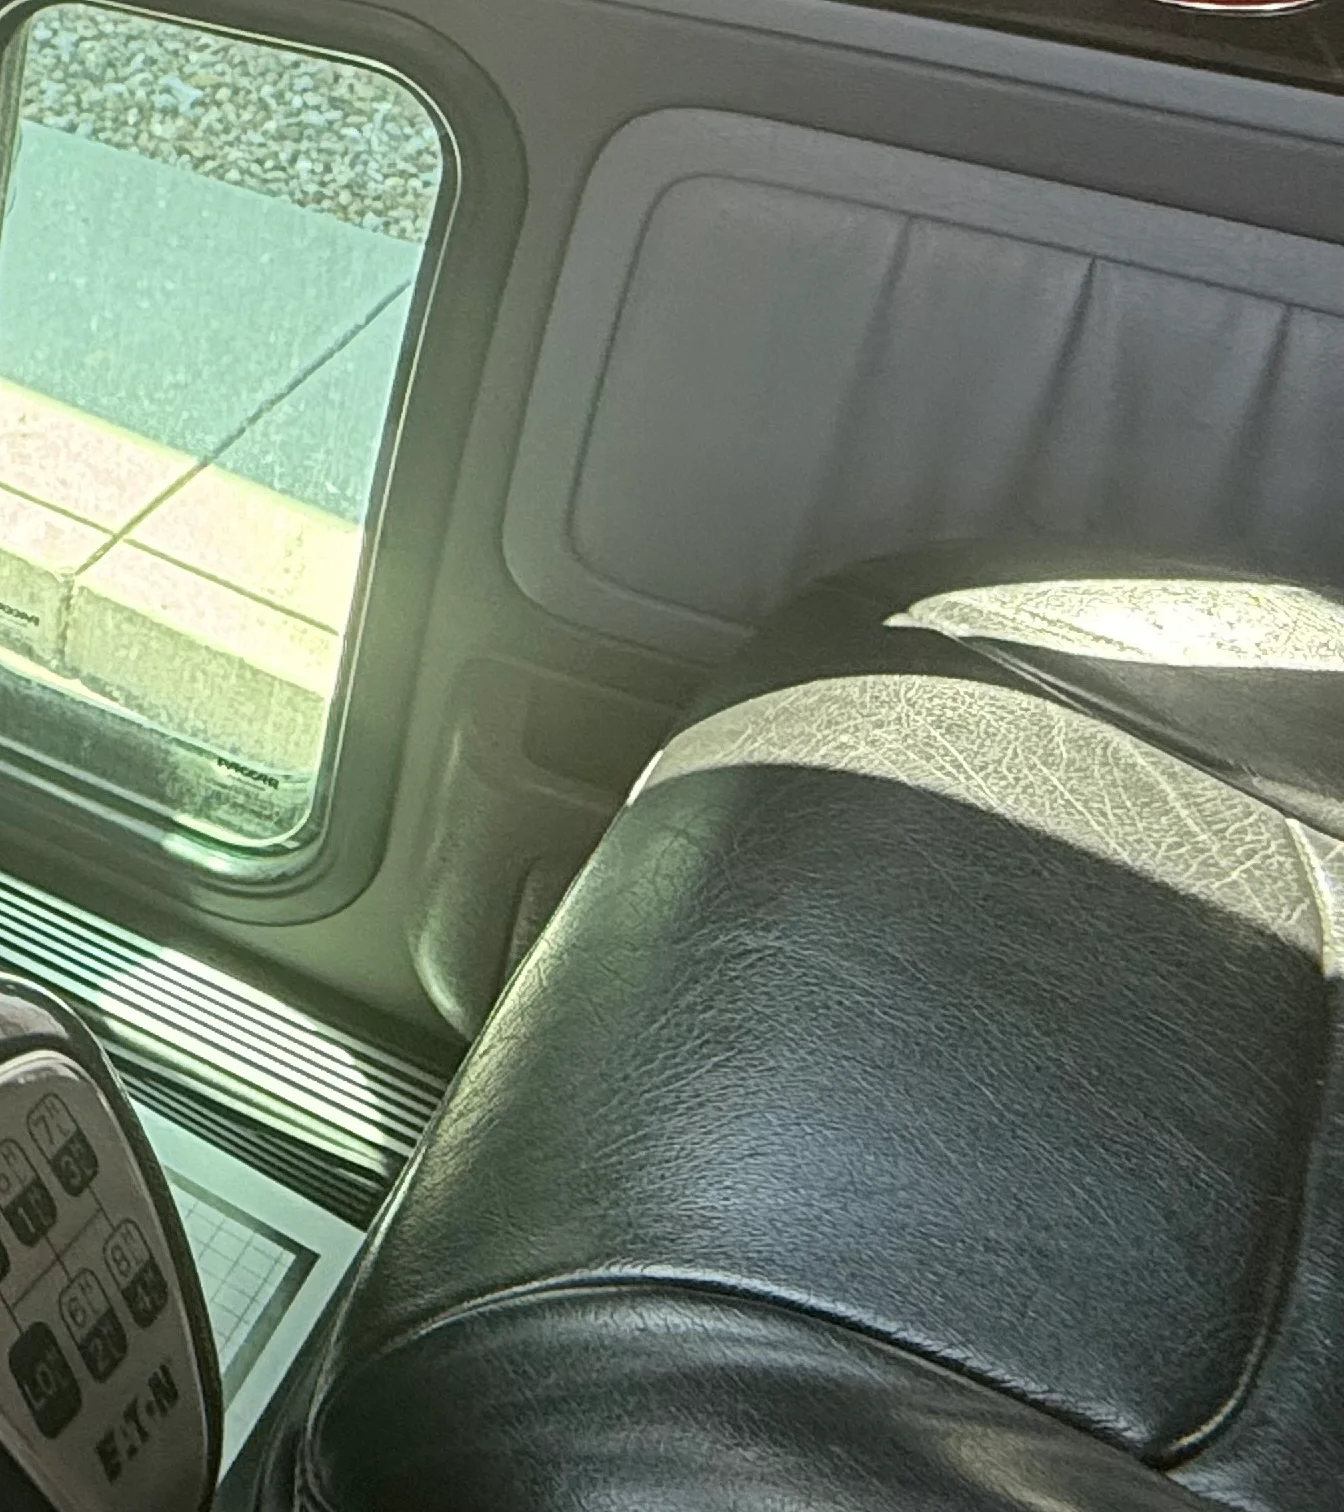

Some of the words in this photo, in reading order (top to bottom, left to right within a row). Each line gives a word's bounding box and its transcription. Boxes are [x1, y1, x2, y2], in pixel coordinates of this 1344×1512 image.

[33, 1114, 55, 1145] 7
[61, 1158, 81, 1186] 3
[18, 1206, 36, 1234] 1
[111, 1244, 131, 1278] 8
[67, 1296, 87, 1329] 6
